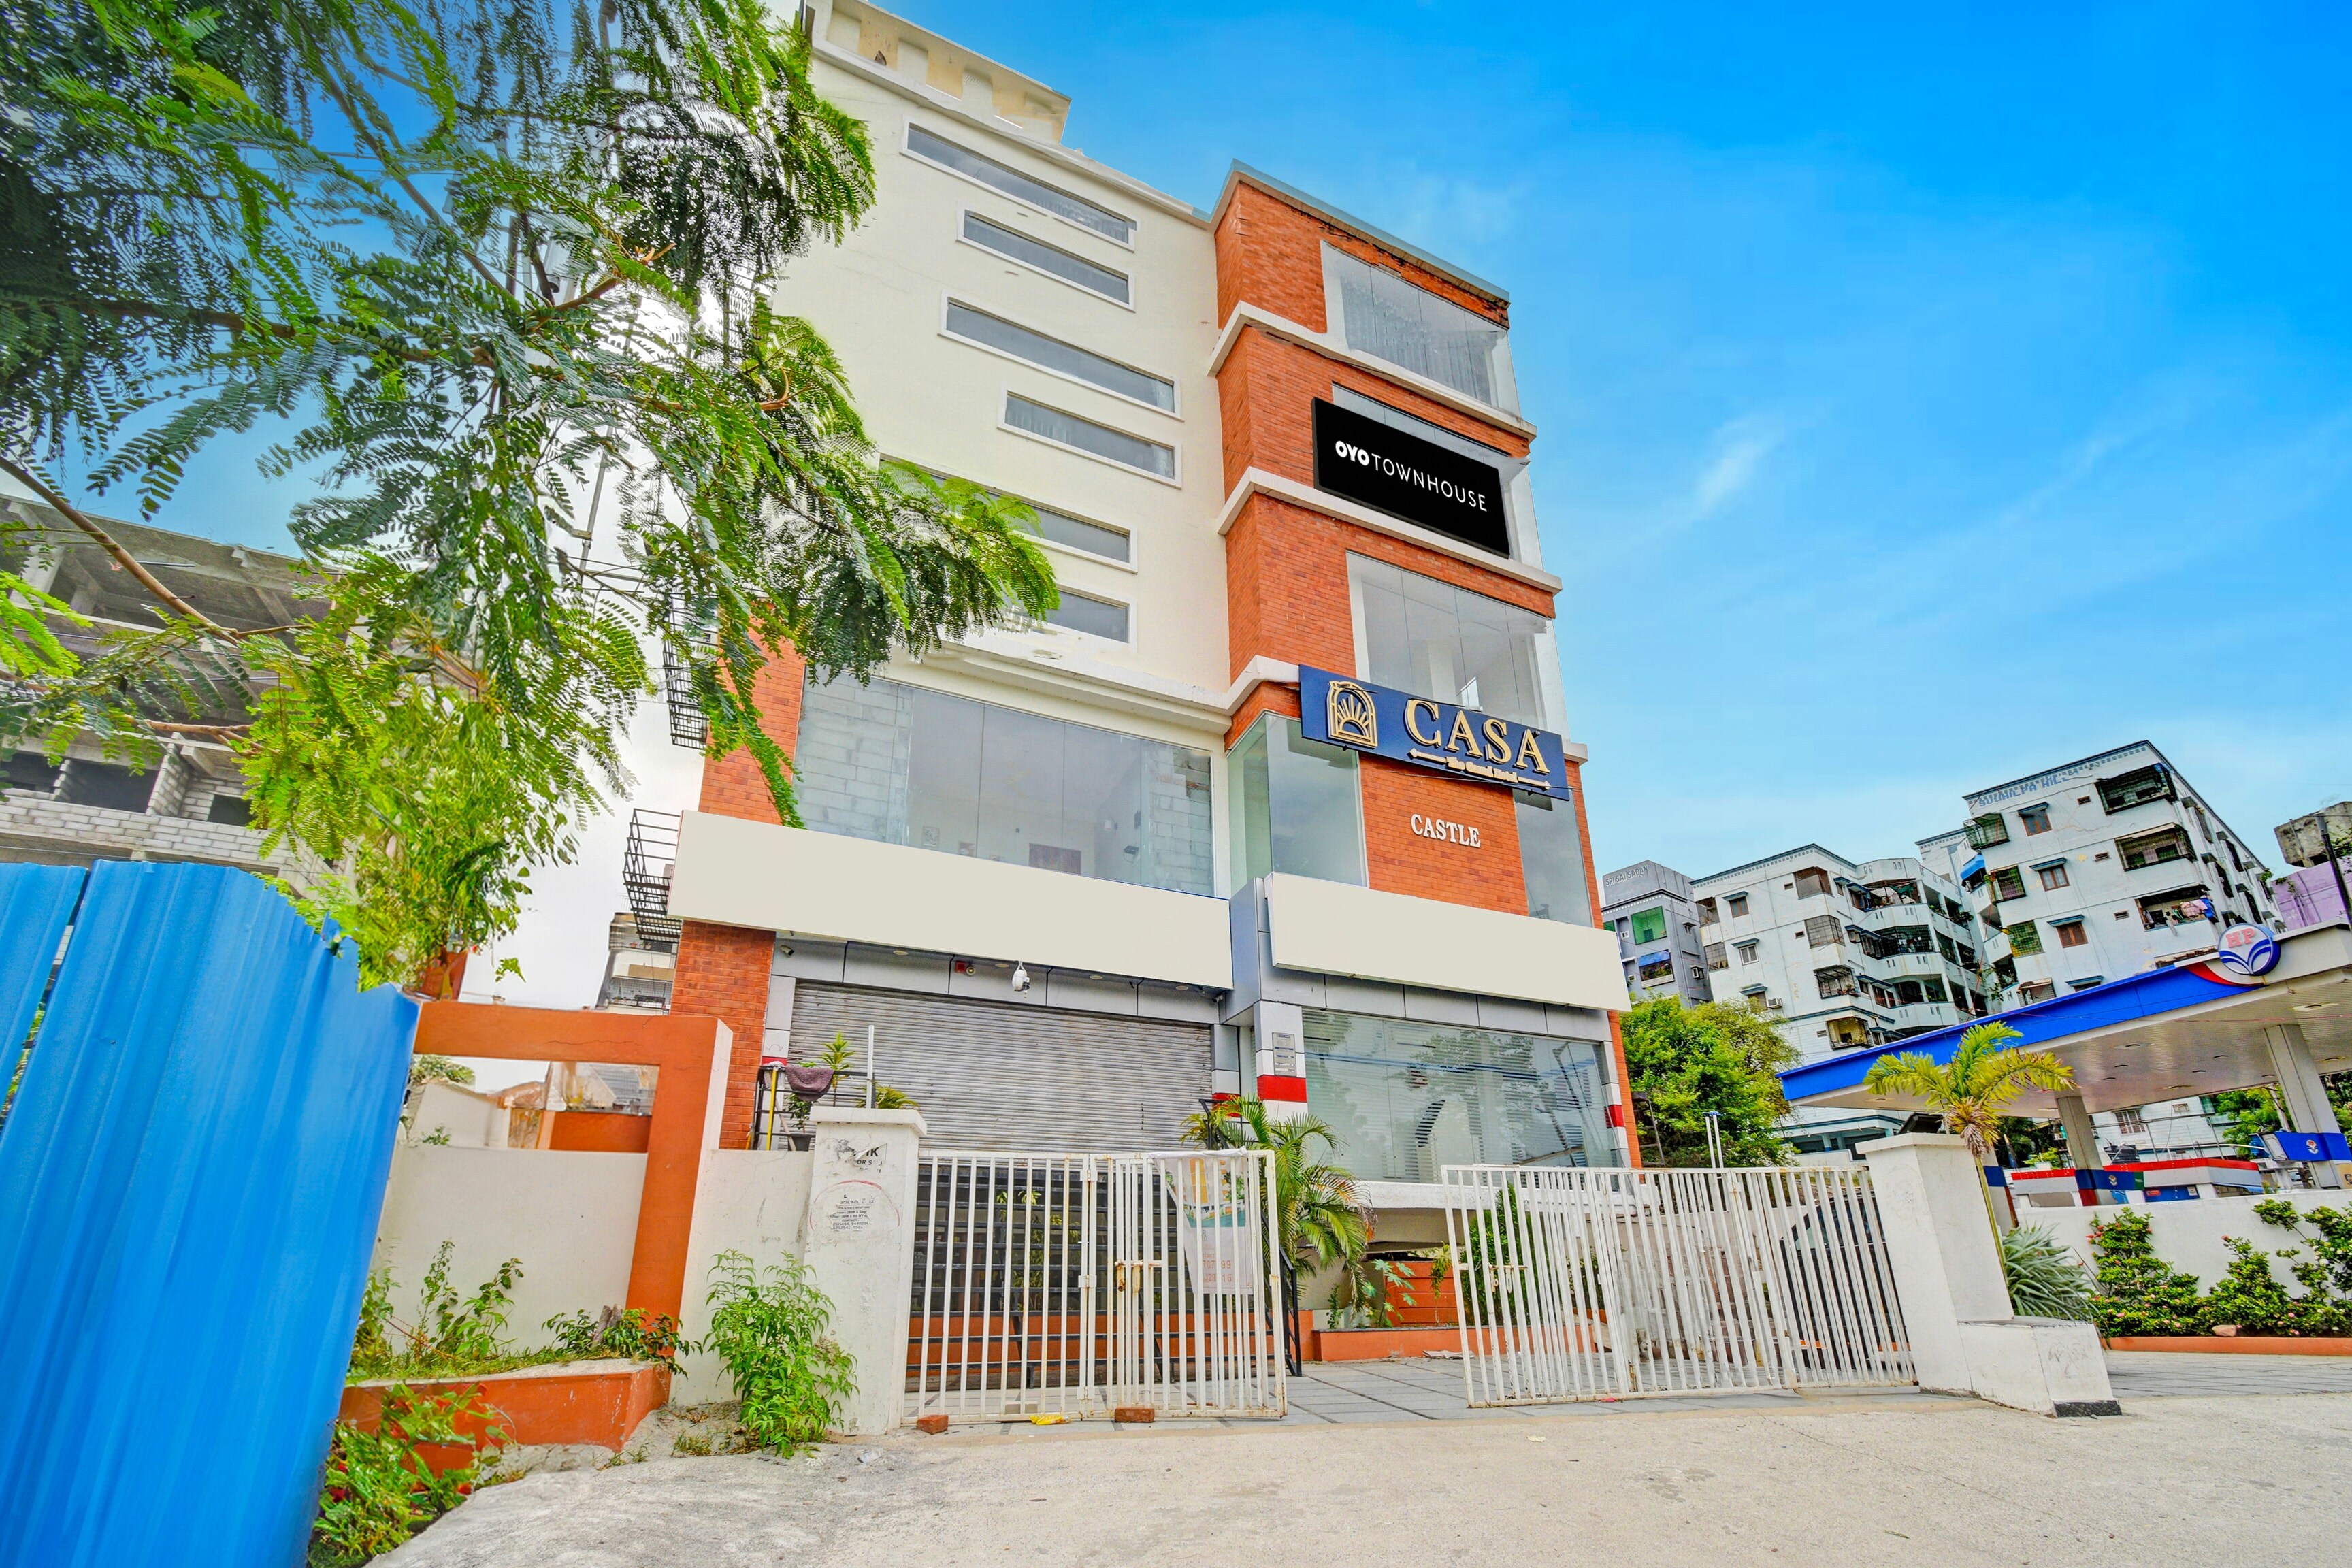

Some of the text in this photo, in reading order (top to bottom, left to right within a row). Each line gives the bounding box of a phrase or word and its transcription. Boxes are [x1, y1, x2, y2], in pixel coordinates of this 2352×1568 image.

[1335, 440, 1487, 511] OYO TOWNHOUSE
[1404, 698, 1550, 774] CASA
[1411, 814, 1481, 848] CASTLE
[1605, 877, 1615, 886] SRI
[1615, 872, 1627, 883] SAI
[2225, 928, 2255, 948] HP
